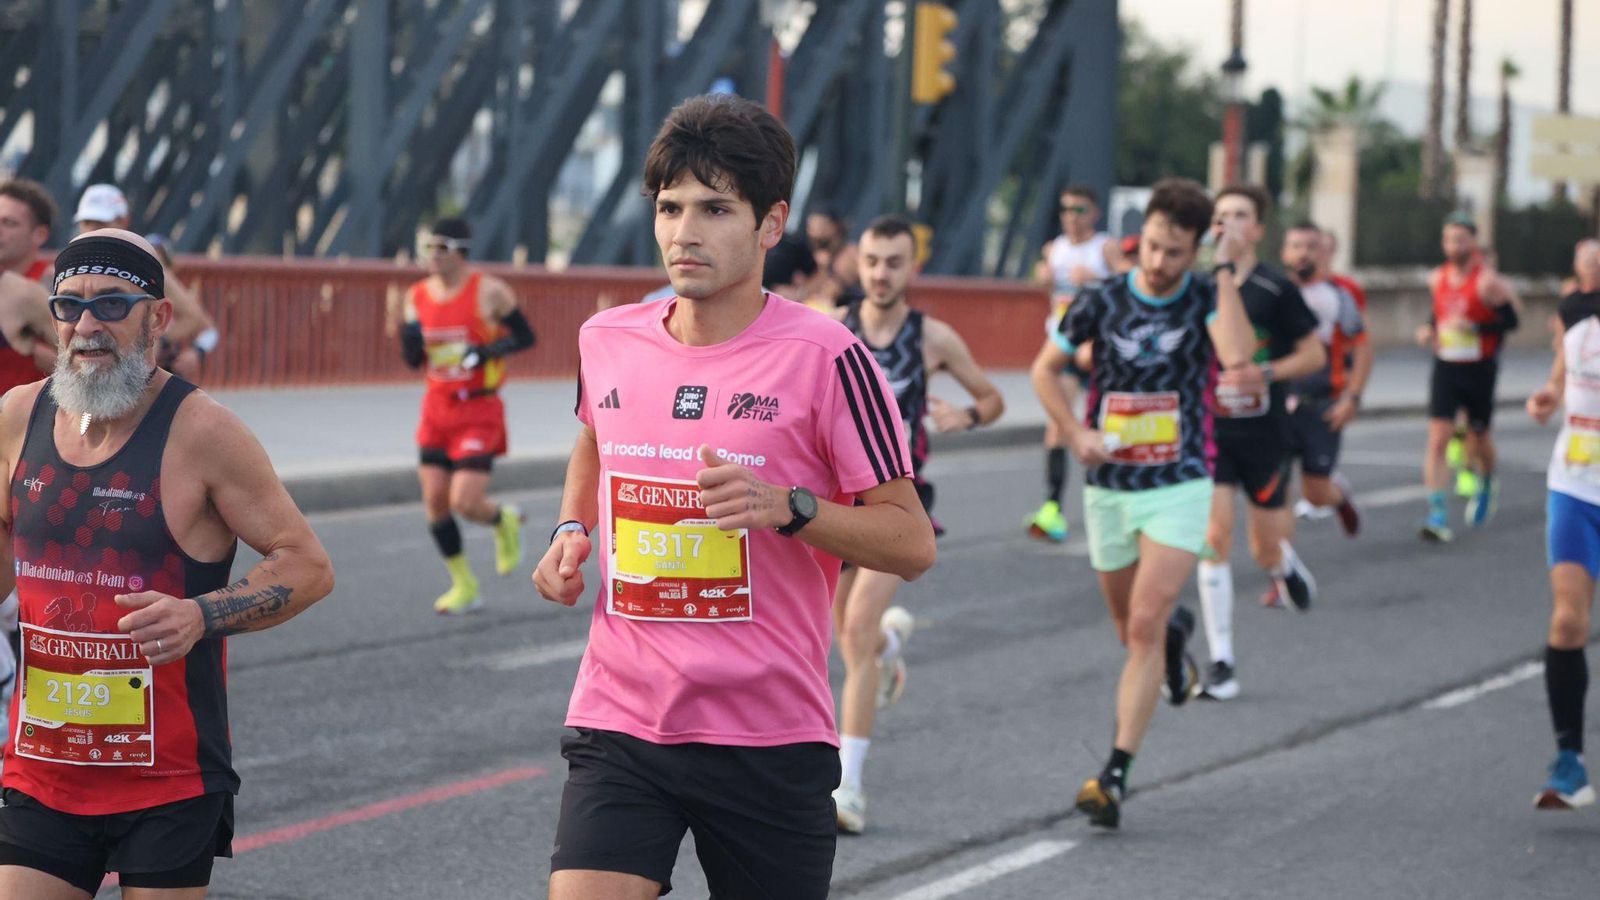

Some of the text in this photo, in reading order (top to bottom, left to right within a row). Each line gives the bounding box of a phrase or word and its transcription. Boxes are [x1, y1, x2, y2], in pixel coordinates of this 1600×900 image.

[601, 441, 612, 455] all
[615, 442, 656, 458] roads
[659, 444, 693, 461] lead
[24, 477, 46, 492] EKT
[639, 485, 704, 509] GENER
[638, 529, 704, 558] 5317
[22, 561, 125, 588] Maratonian@s Team
[699, 588, 727, 599] 42K
[47, 636, 140, 661] GENERALI
[46, 679, 111, 708] 2129
[104, 734, 132, 744] 42K
